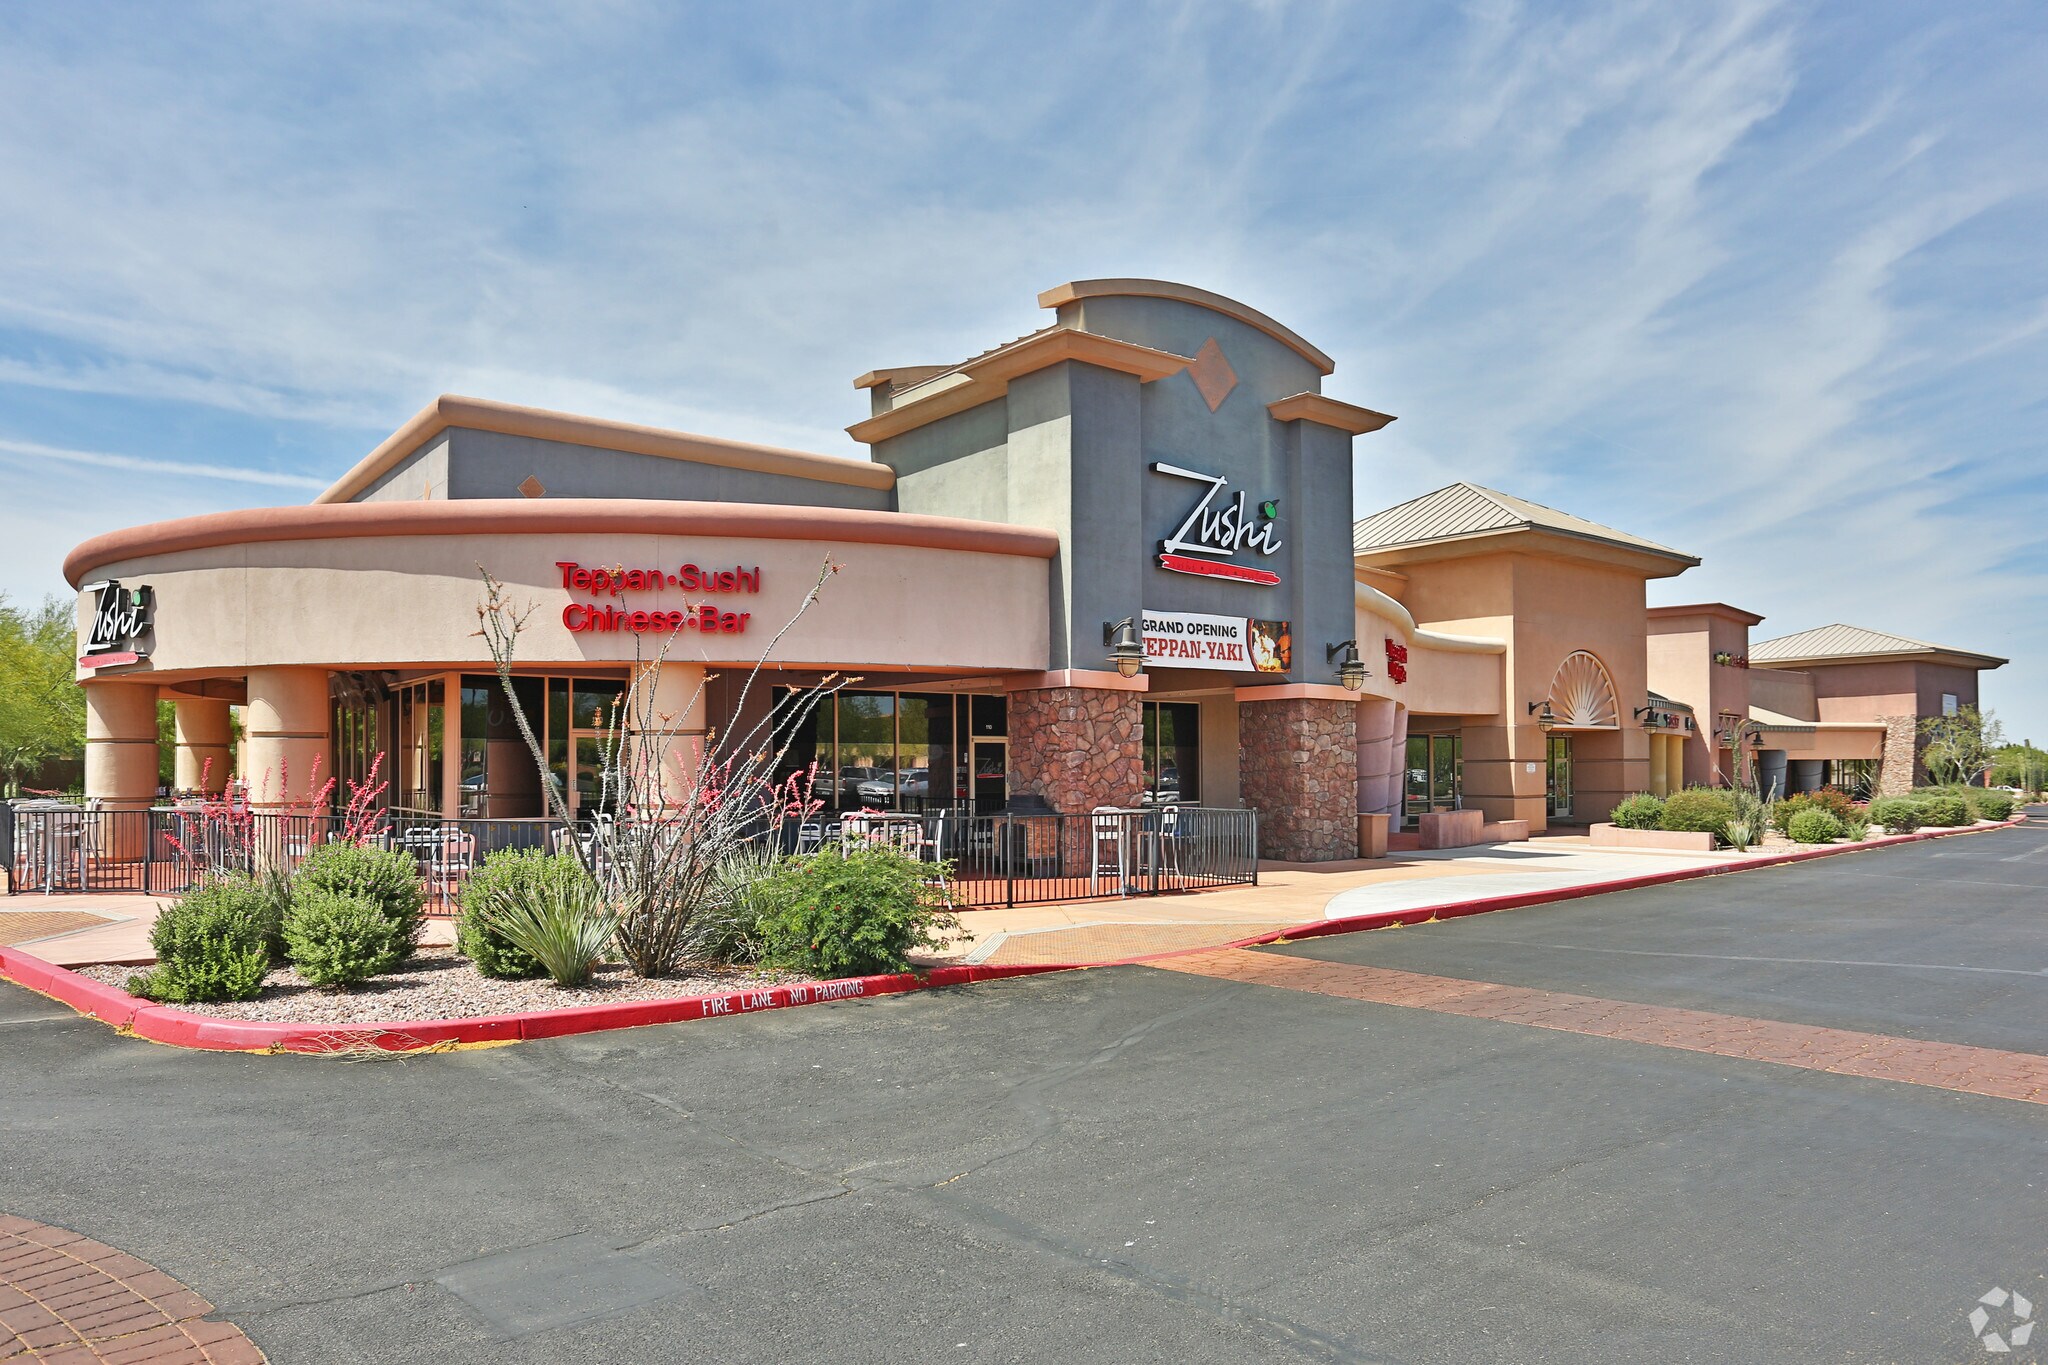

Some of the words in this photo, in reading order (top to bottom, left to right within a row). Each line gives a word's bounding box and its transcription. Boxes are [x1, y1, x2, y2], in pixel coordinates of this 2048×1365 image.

[1156, 462, 1282, 555] Zushi
[83, 579, 144, 655] Zushi
[1142, 619, 1184, 634] GRAND
[1186, 622, 1238, 638] OPENING
[702, 995, 733, 1016] FIRE
[741, 990, 777, 1010] LANE
[790, 988, 808, 1005] NO
[814, 980, 865, 1001] PARKING
